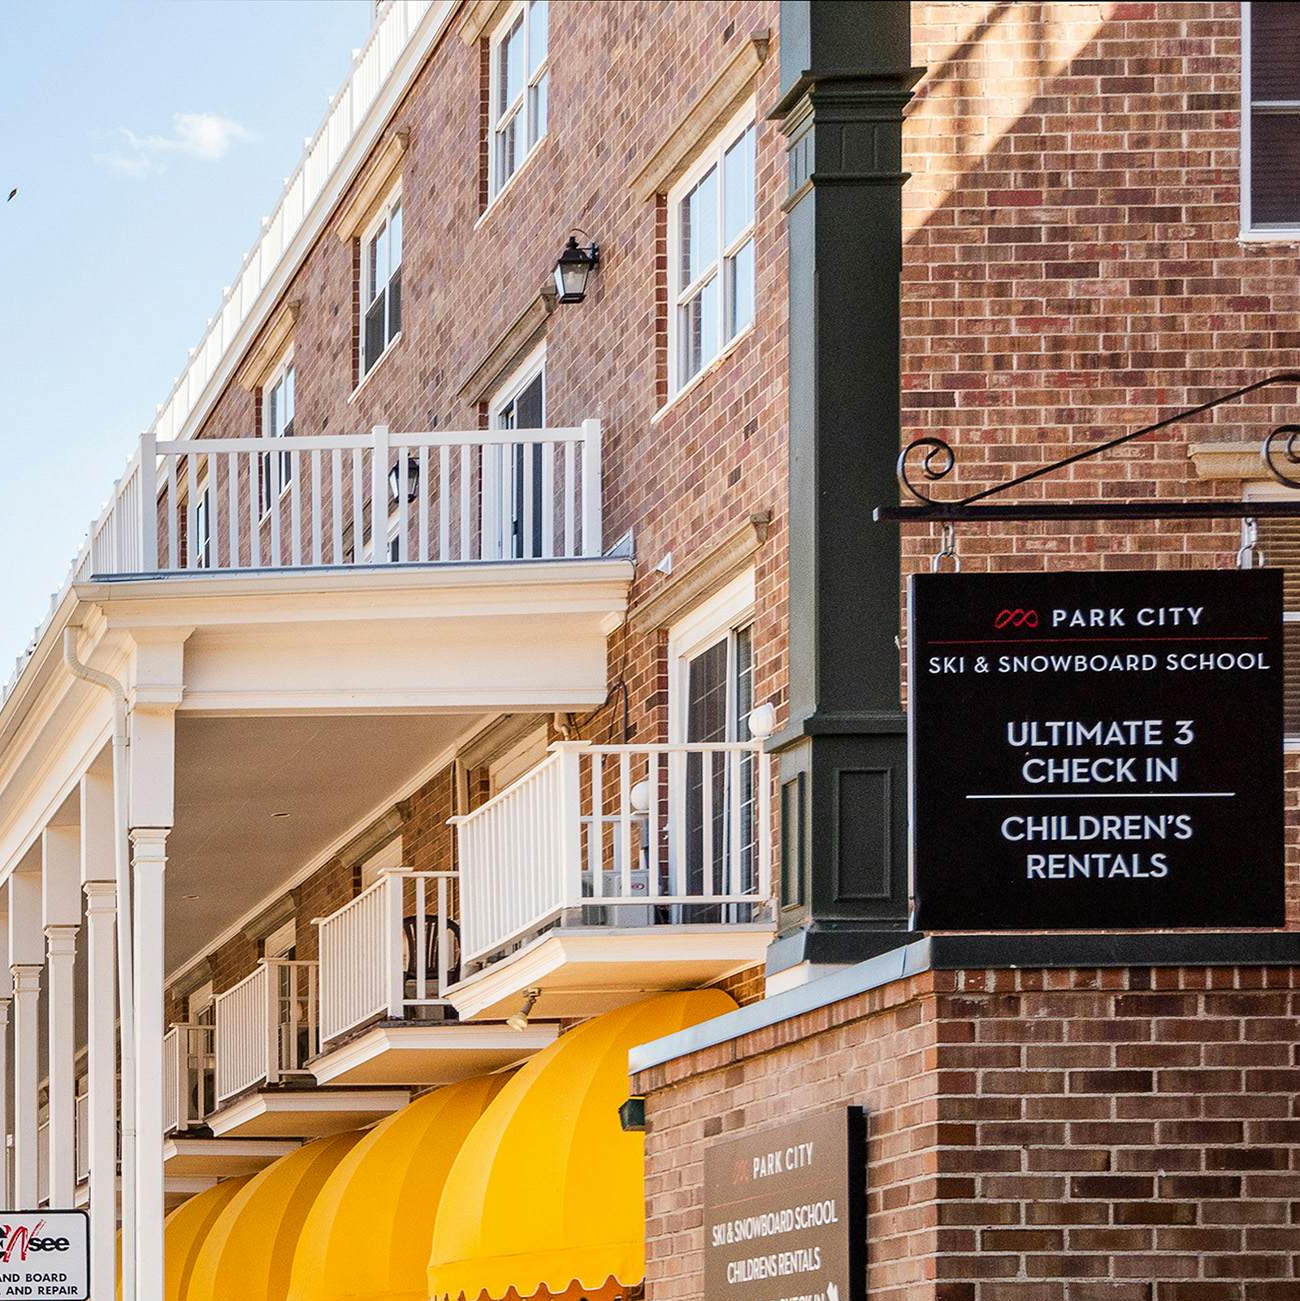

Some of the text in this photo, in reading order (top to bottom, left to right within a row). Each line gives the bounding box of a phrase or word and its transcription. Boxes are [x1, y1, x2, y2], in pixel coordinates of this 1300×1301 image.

[1052, 607, 1204, 628] PARK CITY
[928, 652, 1270, 675] SKI & SNOWBOARD SCHOOL
[1007, 720, 1195, 747] ULTIMATE 3
[1022, 757, 1178, 784] CHECK IN
[1001, 814, 1193, 841] CHILDREN'S
[1026, 853, 1169, 879] RENTALS
[753, 1142, 814, 1179] PARK CITY
[712, 1200, 839, 1247] SKI & SNOWBOARD SCHOOL
[26, 1273, 68, 1283] BOARD
[727, 1247, 822, 1284] CHILDRENS RENTALS
[6, 1286, 32, 1295] AND
[38, 1286, 78, 1295] REPAIR
